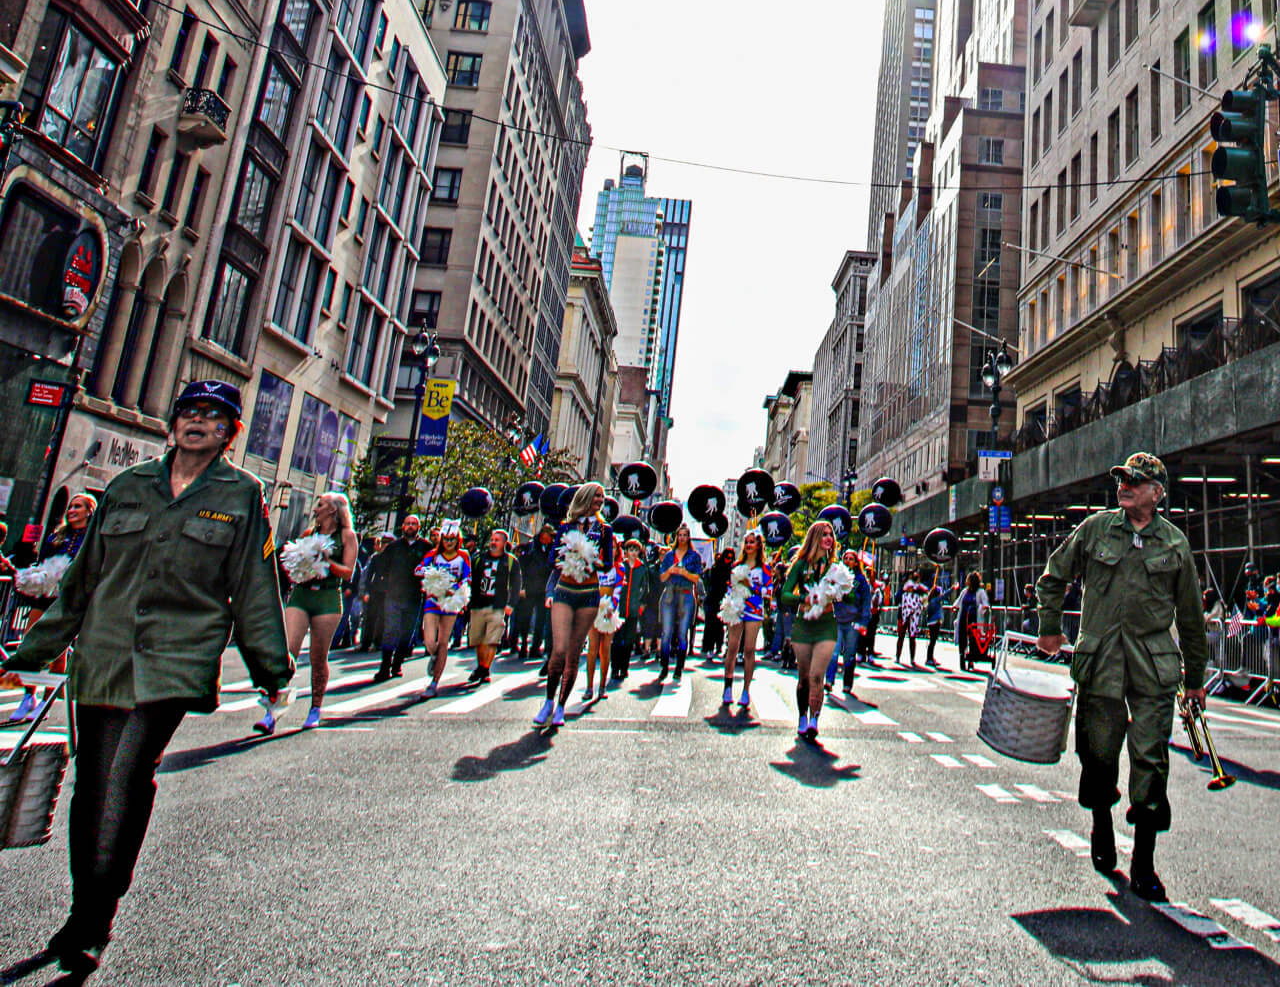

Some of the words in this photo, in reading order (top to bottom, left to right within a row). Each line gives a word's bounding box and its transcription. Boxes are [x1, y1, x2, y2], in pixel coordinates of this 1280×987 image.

[426, 390, 449, 408] Be
[107, 437, 139, 468] MedMen
[211, 512, 234, 524] ARMY
